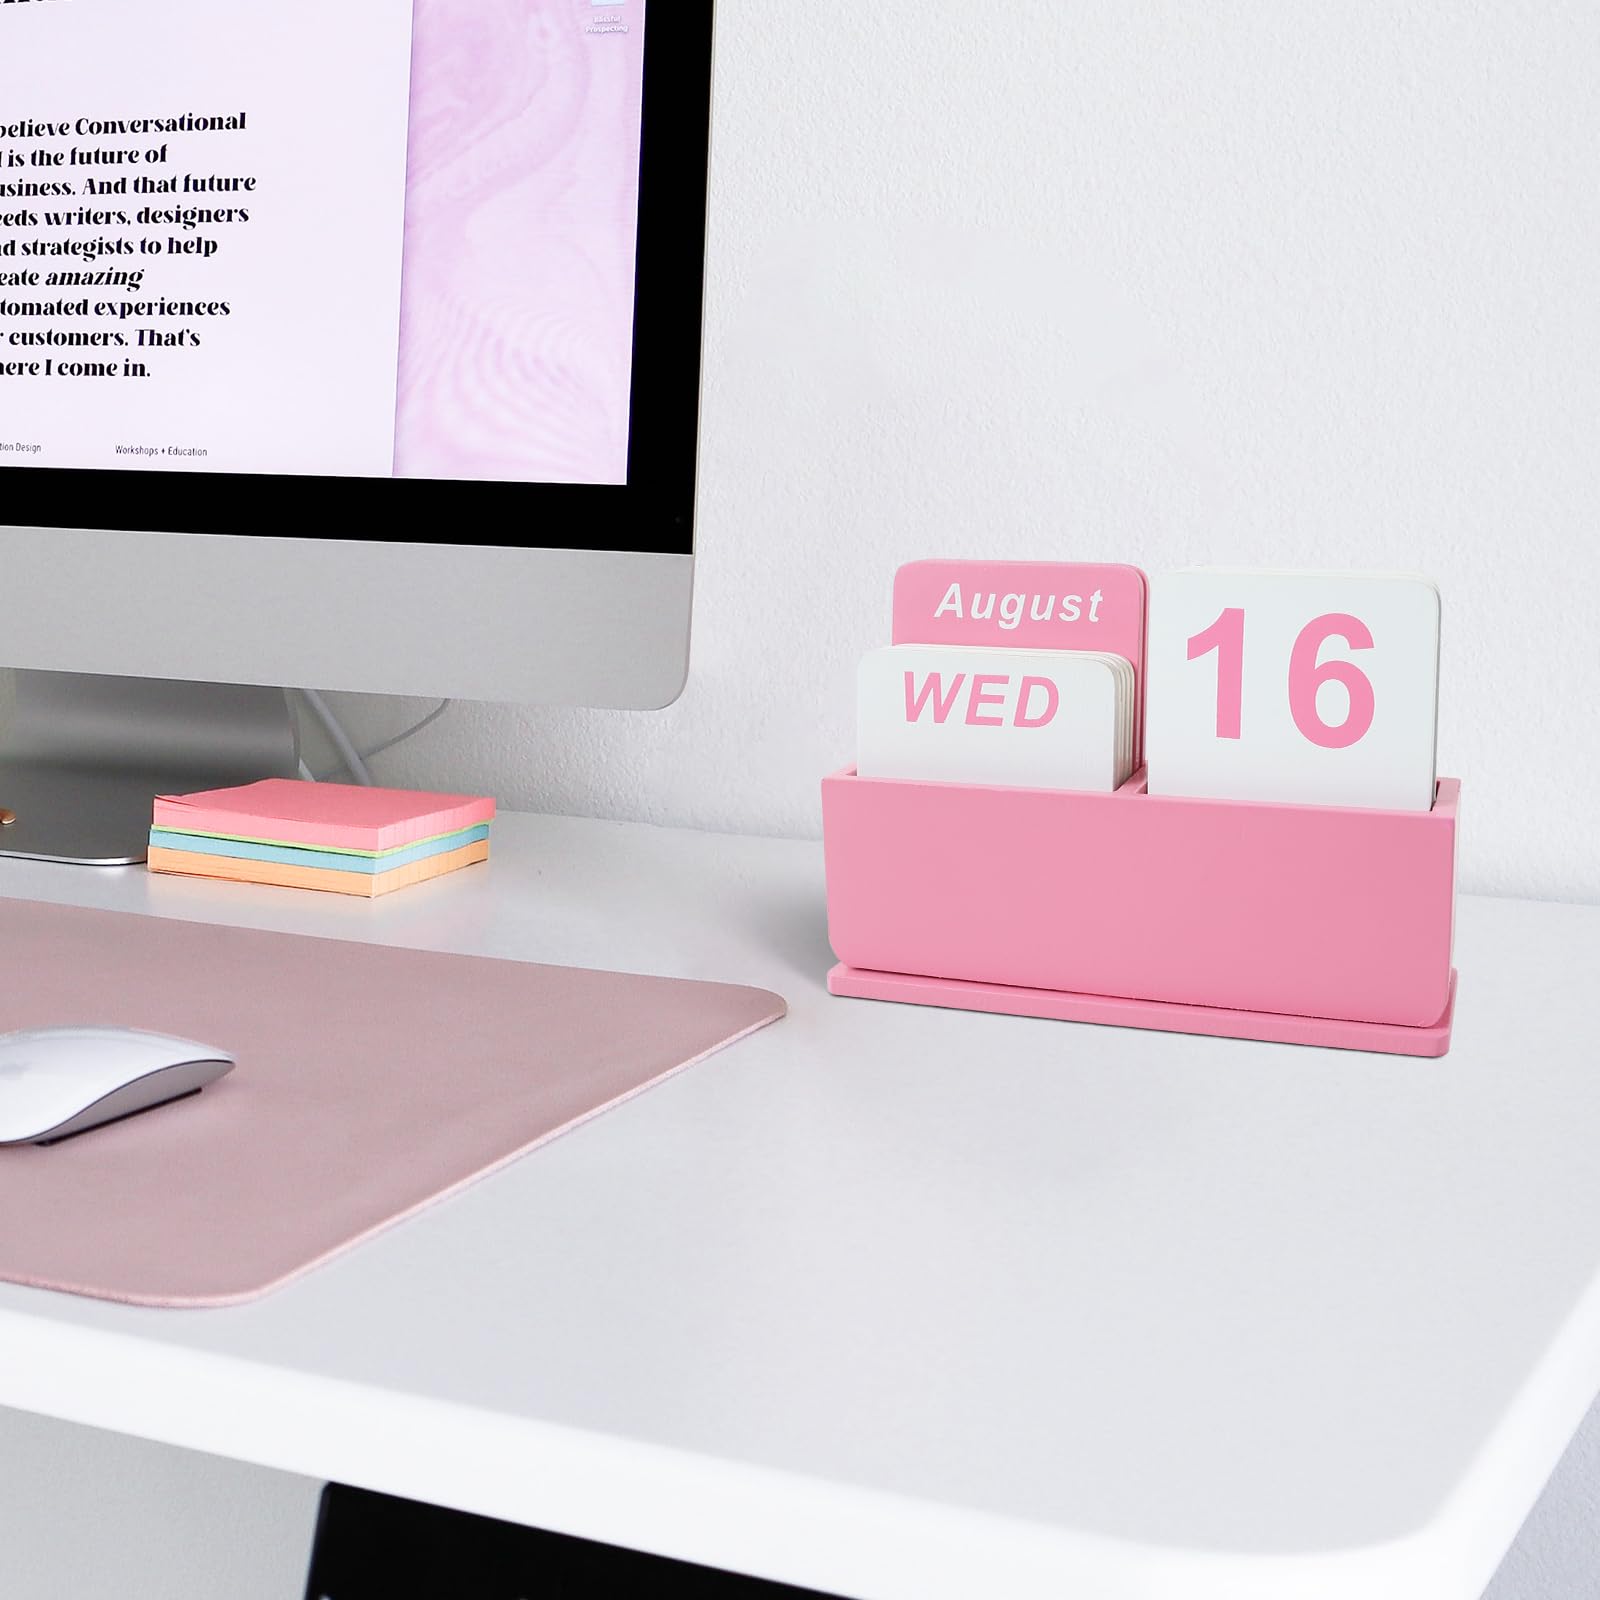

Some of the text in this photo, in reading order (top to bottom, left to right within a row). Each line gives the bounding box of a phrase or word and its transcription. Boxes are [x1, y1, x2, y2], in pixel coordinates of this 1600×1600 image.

[584, 24, 629, 34] Prospecting
[75, 112, 246, 136] Conversational
[7, 149, 25, 168] is
[30, 149, 65, 167] the
[69, 146, 140, 167] future
[144, 143, 168, 164] of
[82, 178, 127, 195] And
[133, 176, 177, 194] that
[182, 173, 257, 193] future
[43, 206, 131, 226] writers,
[136, 204, 250, 231] designers
[21, 237, 134, 263] strategists
[140, 237, 162, 255] to
[167, 236, 218, 258] help
[44, 267, 145, 293] amazing
[93, 297, 231, 320] experiences
[8, 329, 129, 347] customers.
[134, 328, 201, 347] That's
[45, 359, 53, 376] I
[57, 363, 118, 377] come
[123, 358, 151, 378] in.
[15, 442, 42, 455] Design
[115, 444, 159, 458] Workshops
[167, 446, 208, 457] Education
[933, 582, 1104, 631] August
[1186, 607, 1376, 750] 16
[902, 670, 1061, 729] WED
